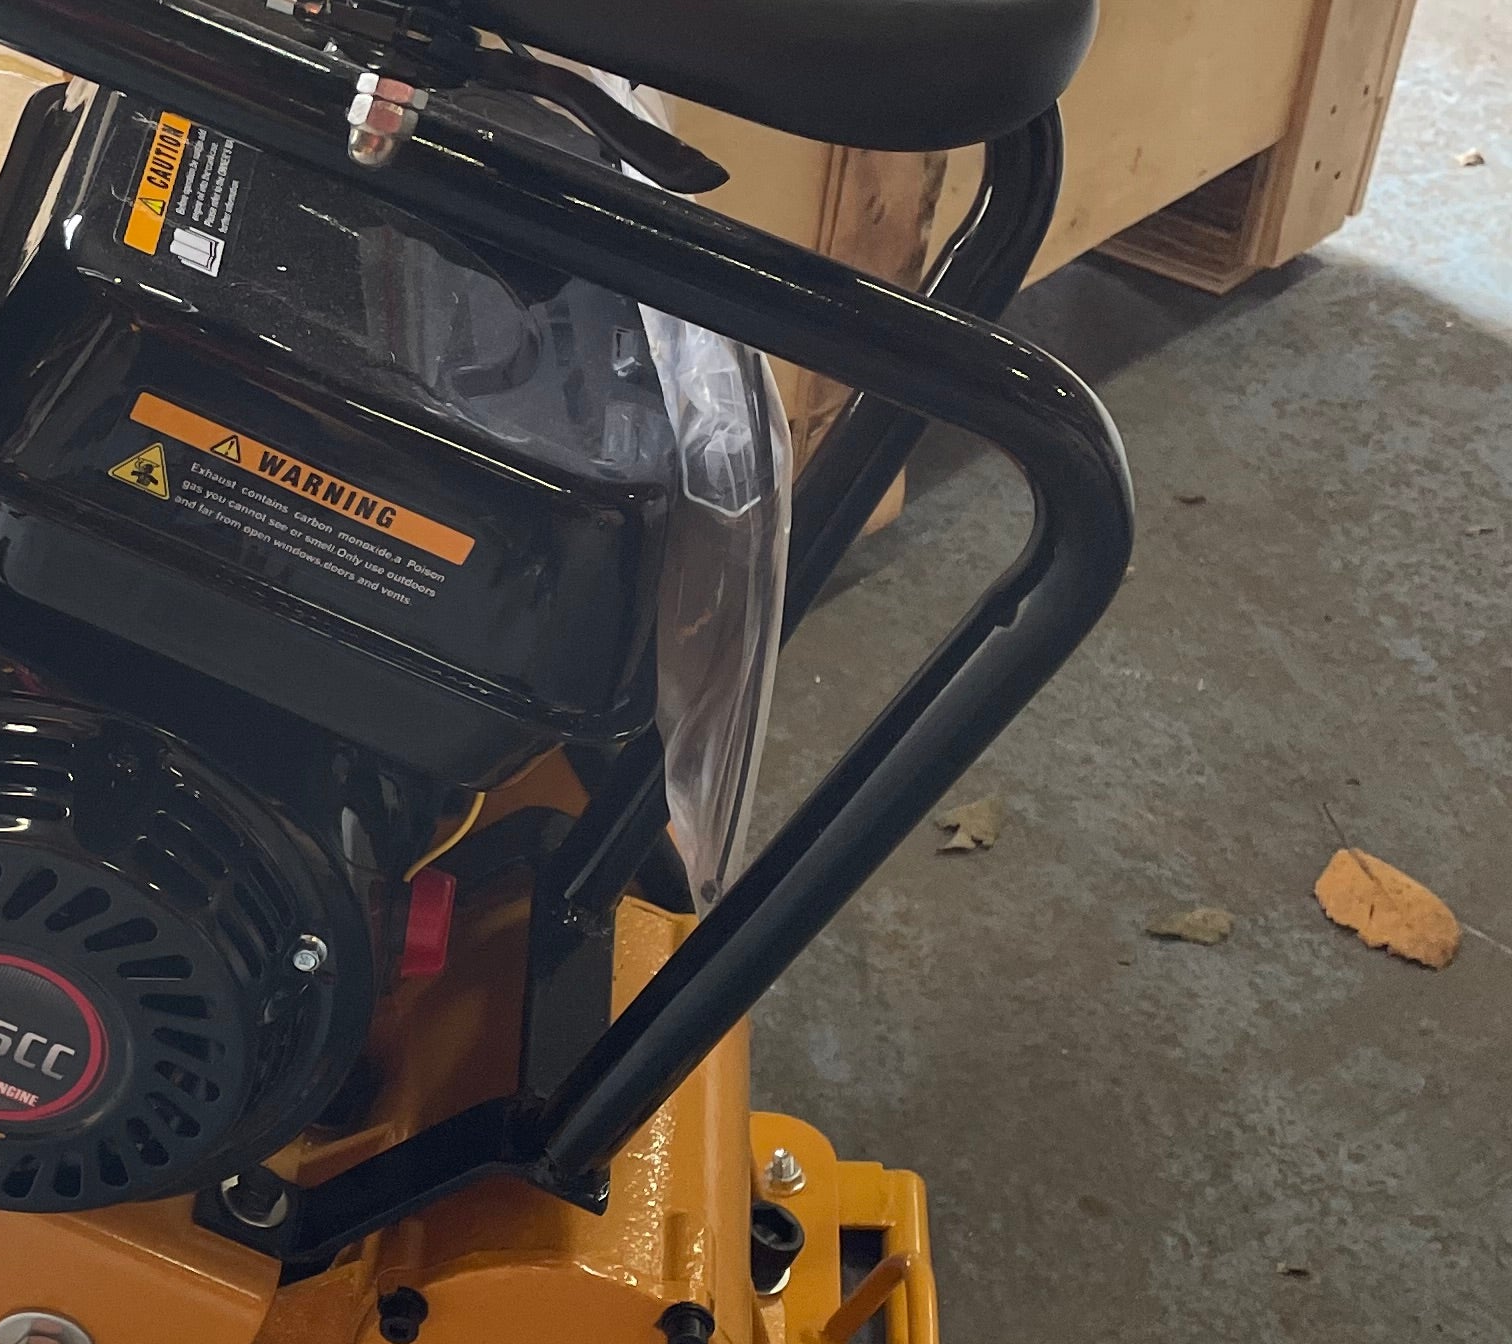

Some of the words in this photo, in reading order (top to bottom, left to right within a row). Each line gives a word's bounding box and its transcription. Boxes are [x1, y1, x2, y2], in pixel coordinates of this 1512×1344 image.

[147, 123, 185, 189] CAUTION
[190, 462, 238, 490] Exhaust
[240, 486, 290, 513] contains
[293, 510, 334, 533] carbon
[406, 558, 446, 583] Poison
[258, 450, 397, 529] WARNING
[174, 495, 198, 510] and
[197, 503, 213, 517] far
[215, 511, 242, 530] from
[242, 525, 272, 543] open
[357, 575, 381, 590] and
[180, 479, 204, 494] gas
[203, 489, 227, 504] you
[227, 499, 267, 522] cannot
[268, 517, 289, 532] see
[290, 527, 304, 538] or
[364, 560, 386, 574] use
[386, 570, 437, 597] outdoors
